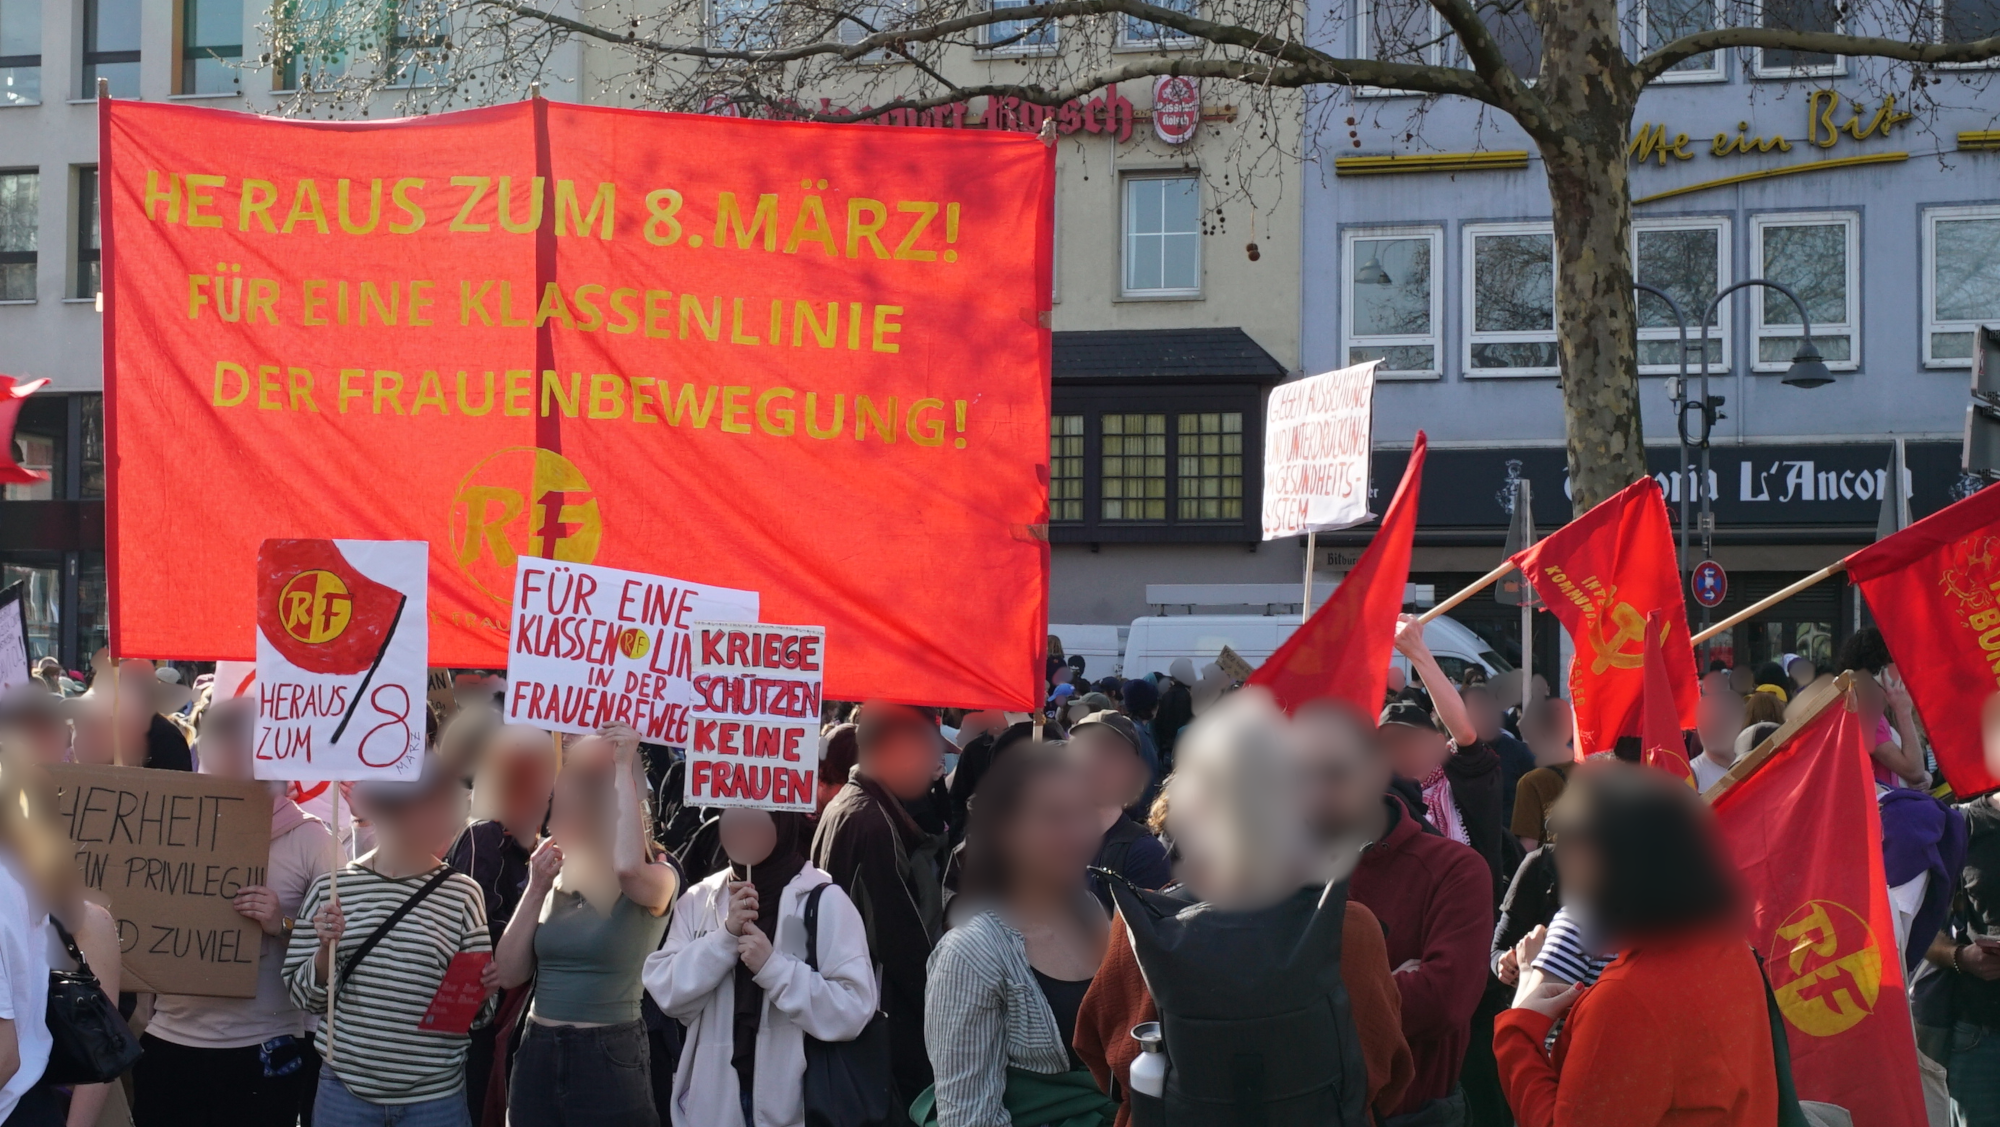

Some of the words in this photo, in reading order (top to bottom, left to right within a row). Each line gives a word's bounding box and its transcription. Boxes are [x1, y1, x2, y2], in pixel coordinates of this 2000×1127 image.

[1710, 120, 1792, 157] ein
[1808, 89, 1912, 148] Bit
[448, 175, 616, 241] ZUM
[187, 262, 280, 325] FÜR
[303, 279, 436, 326] EINE
[460, 279, 904, 354] KLASSENLINIE
[213, 361, 319, 413] DER
[338, 367, 968, 449] FRAUENBEWEGUNG!
[1269, 379, 1306, 424] GEGEN
[1275, 461, 1362, 499] GESUNDHEITS-
[520, 566, 597, 616] FÜR
[617, 579, 699, 631] EINE
[516, 613, 623, 667] KLASSEN
[701, 628, 820, 672] KRIEGE
[260, 682, 348, 722] HERAUS
[588, 667, 614, 688] IN
[624, 670, 667, 701] DER
[692, 672, 822, 719] SCHÜTZEN
[256, 725, 312, 764] ZUM
[357, 683, 411, 768] 8
[693, 719, 806, 762] KEINE
[692, 760, 814, 805] FRAUEN
